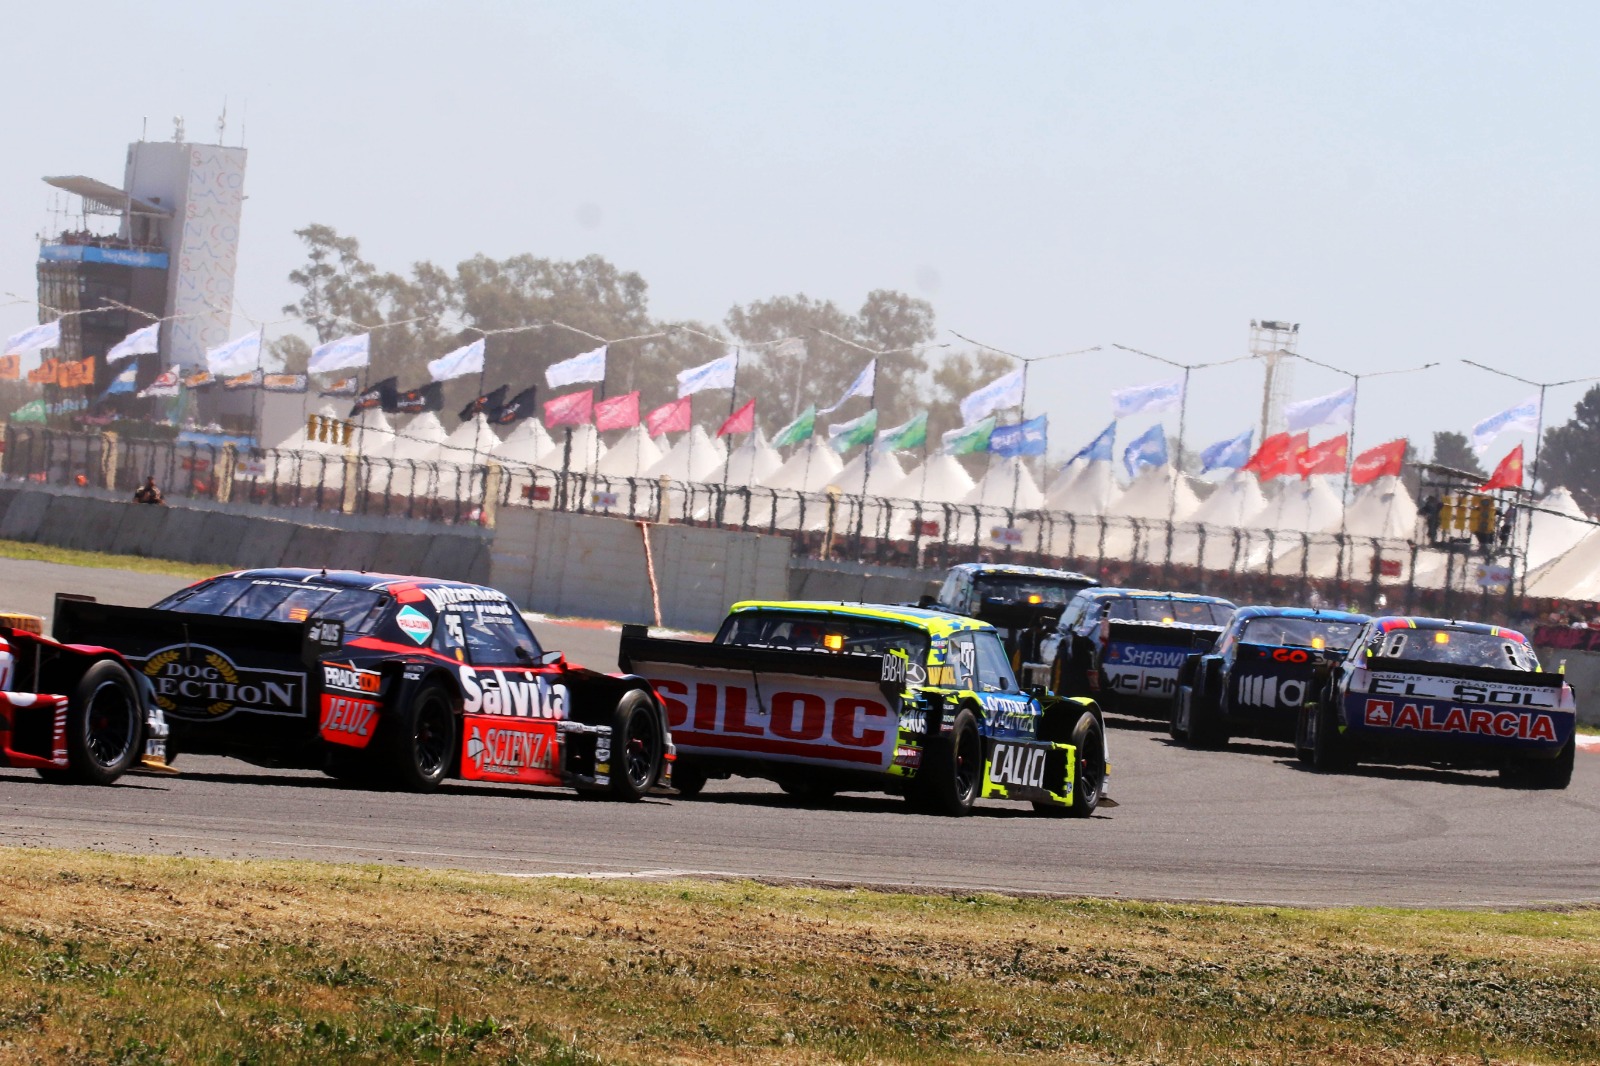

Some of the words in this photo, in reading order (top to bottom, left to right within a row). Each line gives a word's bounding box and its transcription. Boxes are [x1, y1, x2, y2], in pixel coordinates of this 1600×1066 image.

[320, 623, 341, 642] RUS
[166, 663, 220, 680] DOG
[323, 666, 381, 693] PRADECON
[1371, 672, 1422, 683] CASILLAS
[1437, 679, 1504, 690] ACOPLADOS
[1507, 685, 1557, 695] RURALES
[459, 664, 570, 720] Salvita
[1368, 677, 1436, 698] EL
[1452, 685, 1553, 708] SOL
[320, 698, 376, 736] JELUZ
[648, 677, 888, 748] SILOC
[1393, 703, 1558, 742] ALARCIA
[484, 727, 553, 770] SCIENZA
